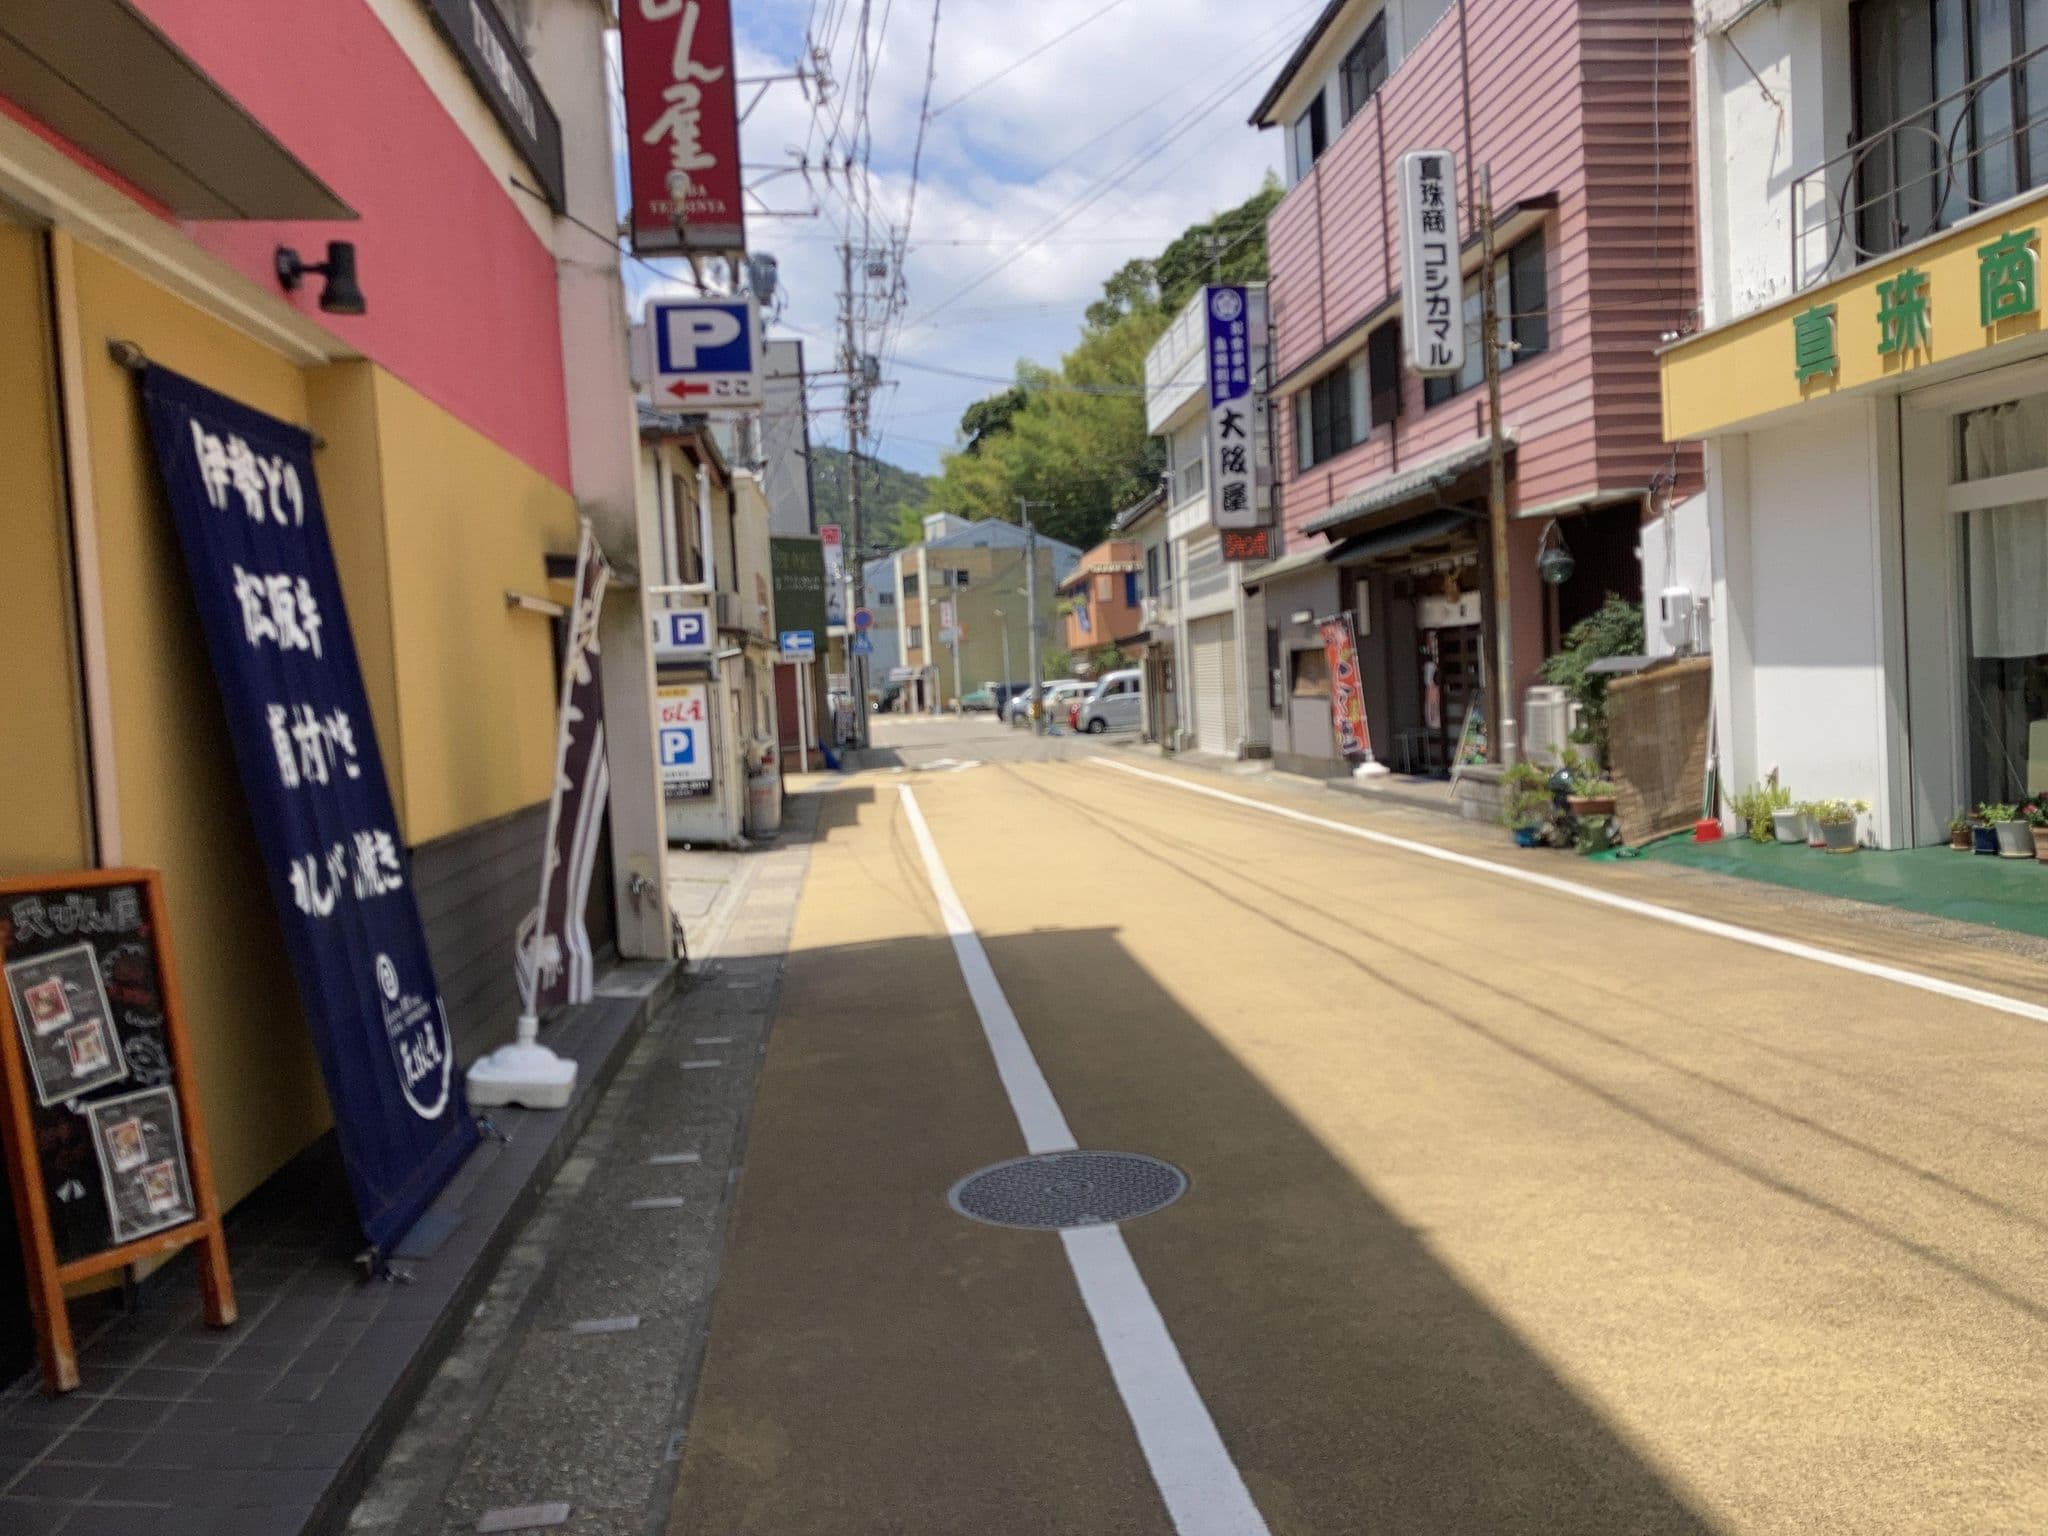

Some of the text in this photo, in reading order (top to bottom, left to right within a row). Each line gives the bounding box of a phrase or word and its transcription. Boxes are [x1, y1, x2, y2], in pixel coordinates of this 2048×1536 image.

[667, 308, 741, 369] P
[1424, 243, 1453, 366] コシカマル
[1793, 228, 2040, 384] 真珠商
[715, 380, 751, 397] ここ
[190, 418, 304, 527] 伊勢どり
[1220, 408, 1248, 512] 大阪屋
[678, 617, 700, 642] P
[662, 731, 690, 766] P
